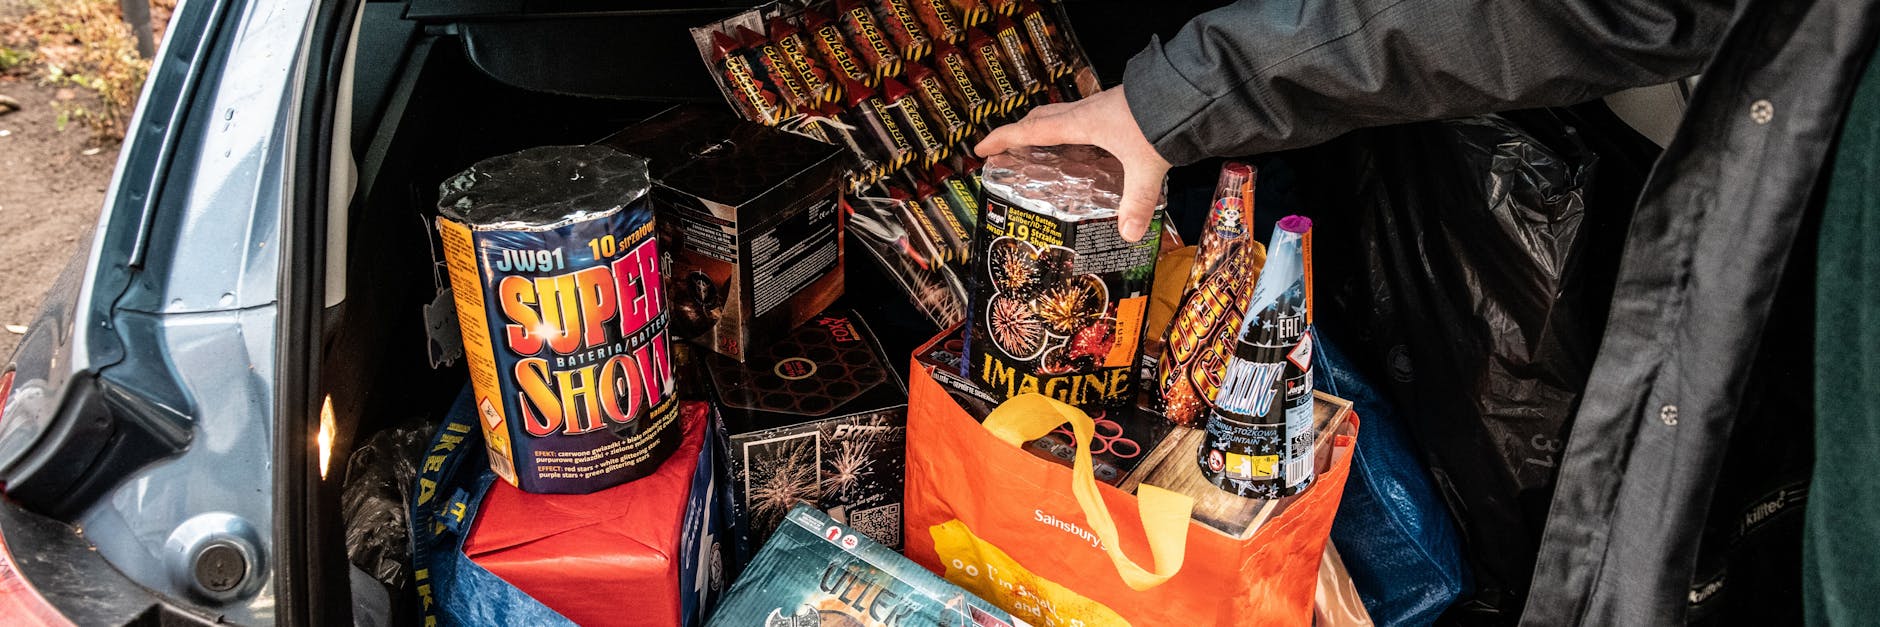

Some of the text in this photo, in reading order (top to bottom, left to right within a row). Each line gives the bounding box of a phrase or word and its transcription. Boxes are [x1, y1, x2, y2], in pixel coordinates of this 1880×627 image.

[944, 55, 983, 105] XPE2736
[980, 44, 1017, 98] XPE2736
[1006, 221, 1029, 242] 19
[1036, 214, 1058, 229] Battery
[1216, 225, 1241, 236] PANDA
[496, 246, 565, 273] JW91
[588, 234, 616, 262] 10
[499, 237, 662, 357] SUPER
[1279, 316, 1301, 339] EAC
[514, 327, 672, 438] SHOW
[981, 352, 1132, 407] IMAGINE
[1222, 431, 1262, 446] FOUNTAIN
[417, 422, 471, 507] IKEA
[538, 471, 562, 480] purple
[562, 471, 579, 479] stars
[584, 469, 605, 479] green
[605, 459, 636, 474] glittering
[635, 452, 650, 464] stars
[564, 465, 576, 473] red
[577, 465, 594, 473] stars
[600, 457, 619, 468] white
[1014, 601, 1042, 619] and
